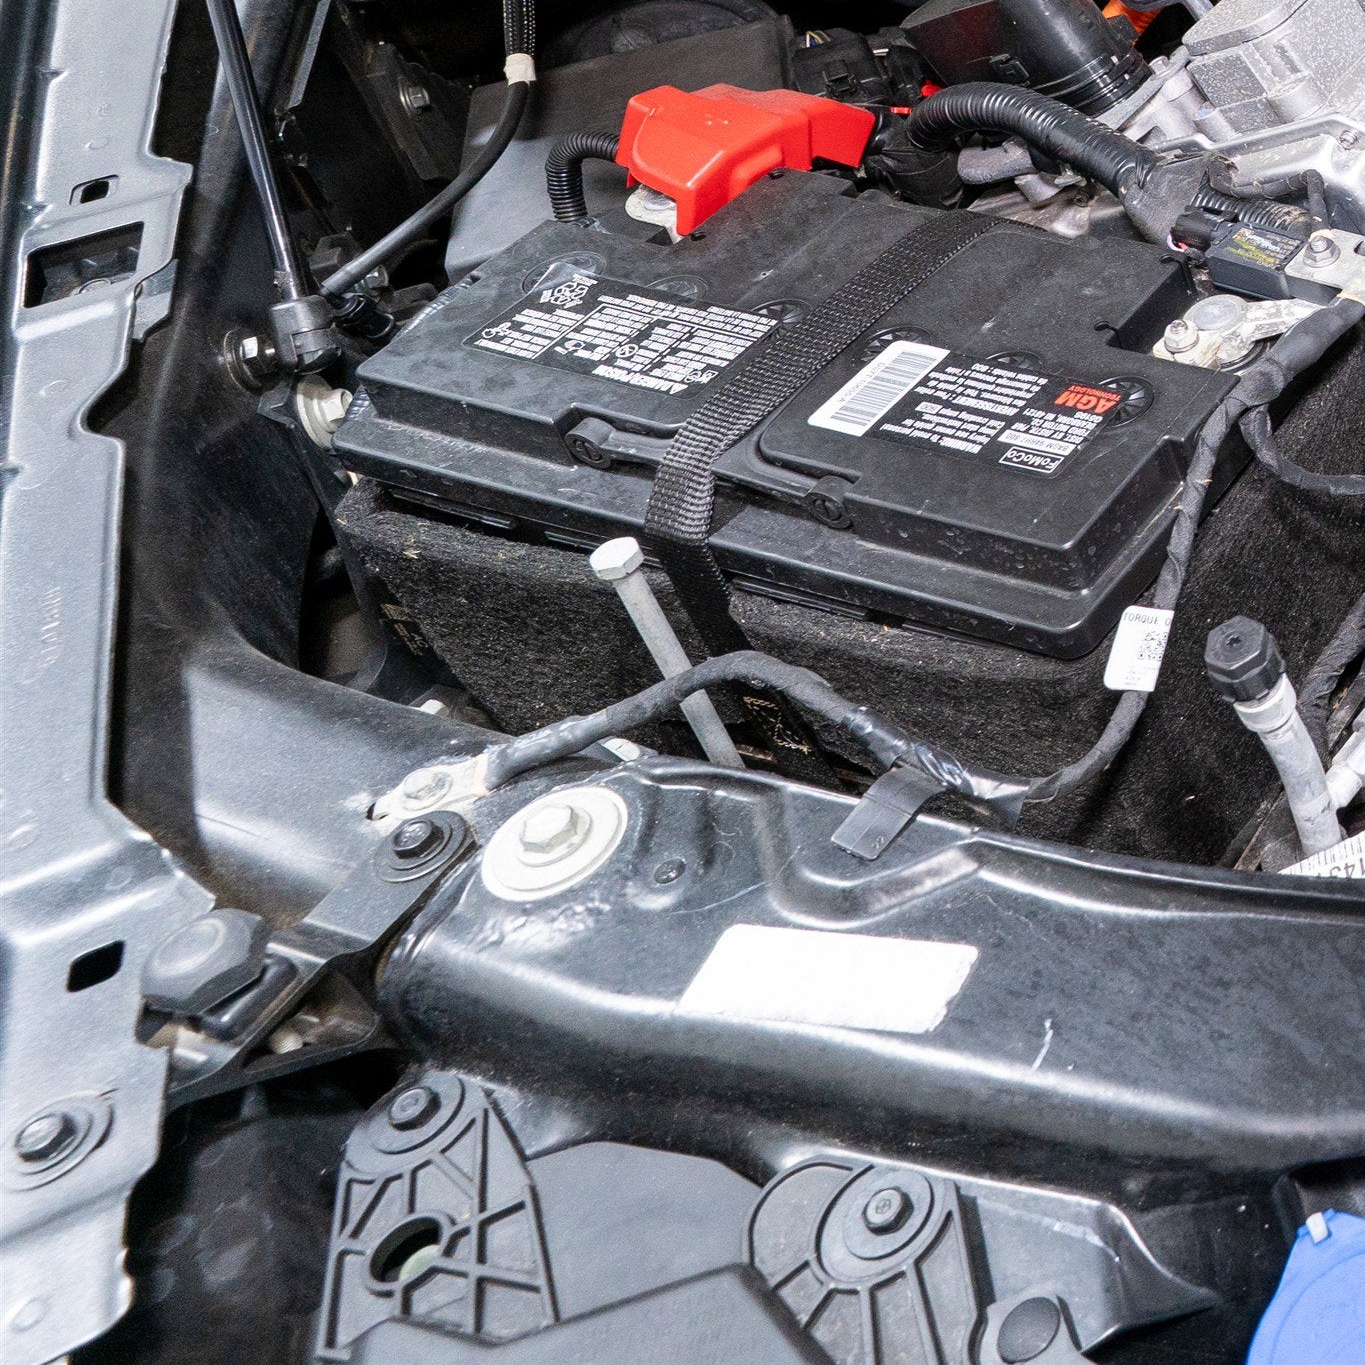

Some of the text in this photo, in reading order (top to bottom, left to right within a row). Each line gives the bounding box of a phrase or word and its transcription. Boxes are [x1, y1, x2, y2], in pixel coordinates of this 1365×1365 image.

[1067, 383, 1122, 401] TECHNOLOGY
[1053, 389, 1117, 415] AGM
[1003, 449, 1059, 469] FoMoCo
[1123, 612, 1159, 625] TORQUE
